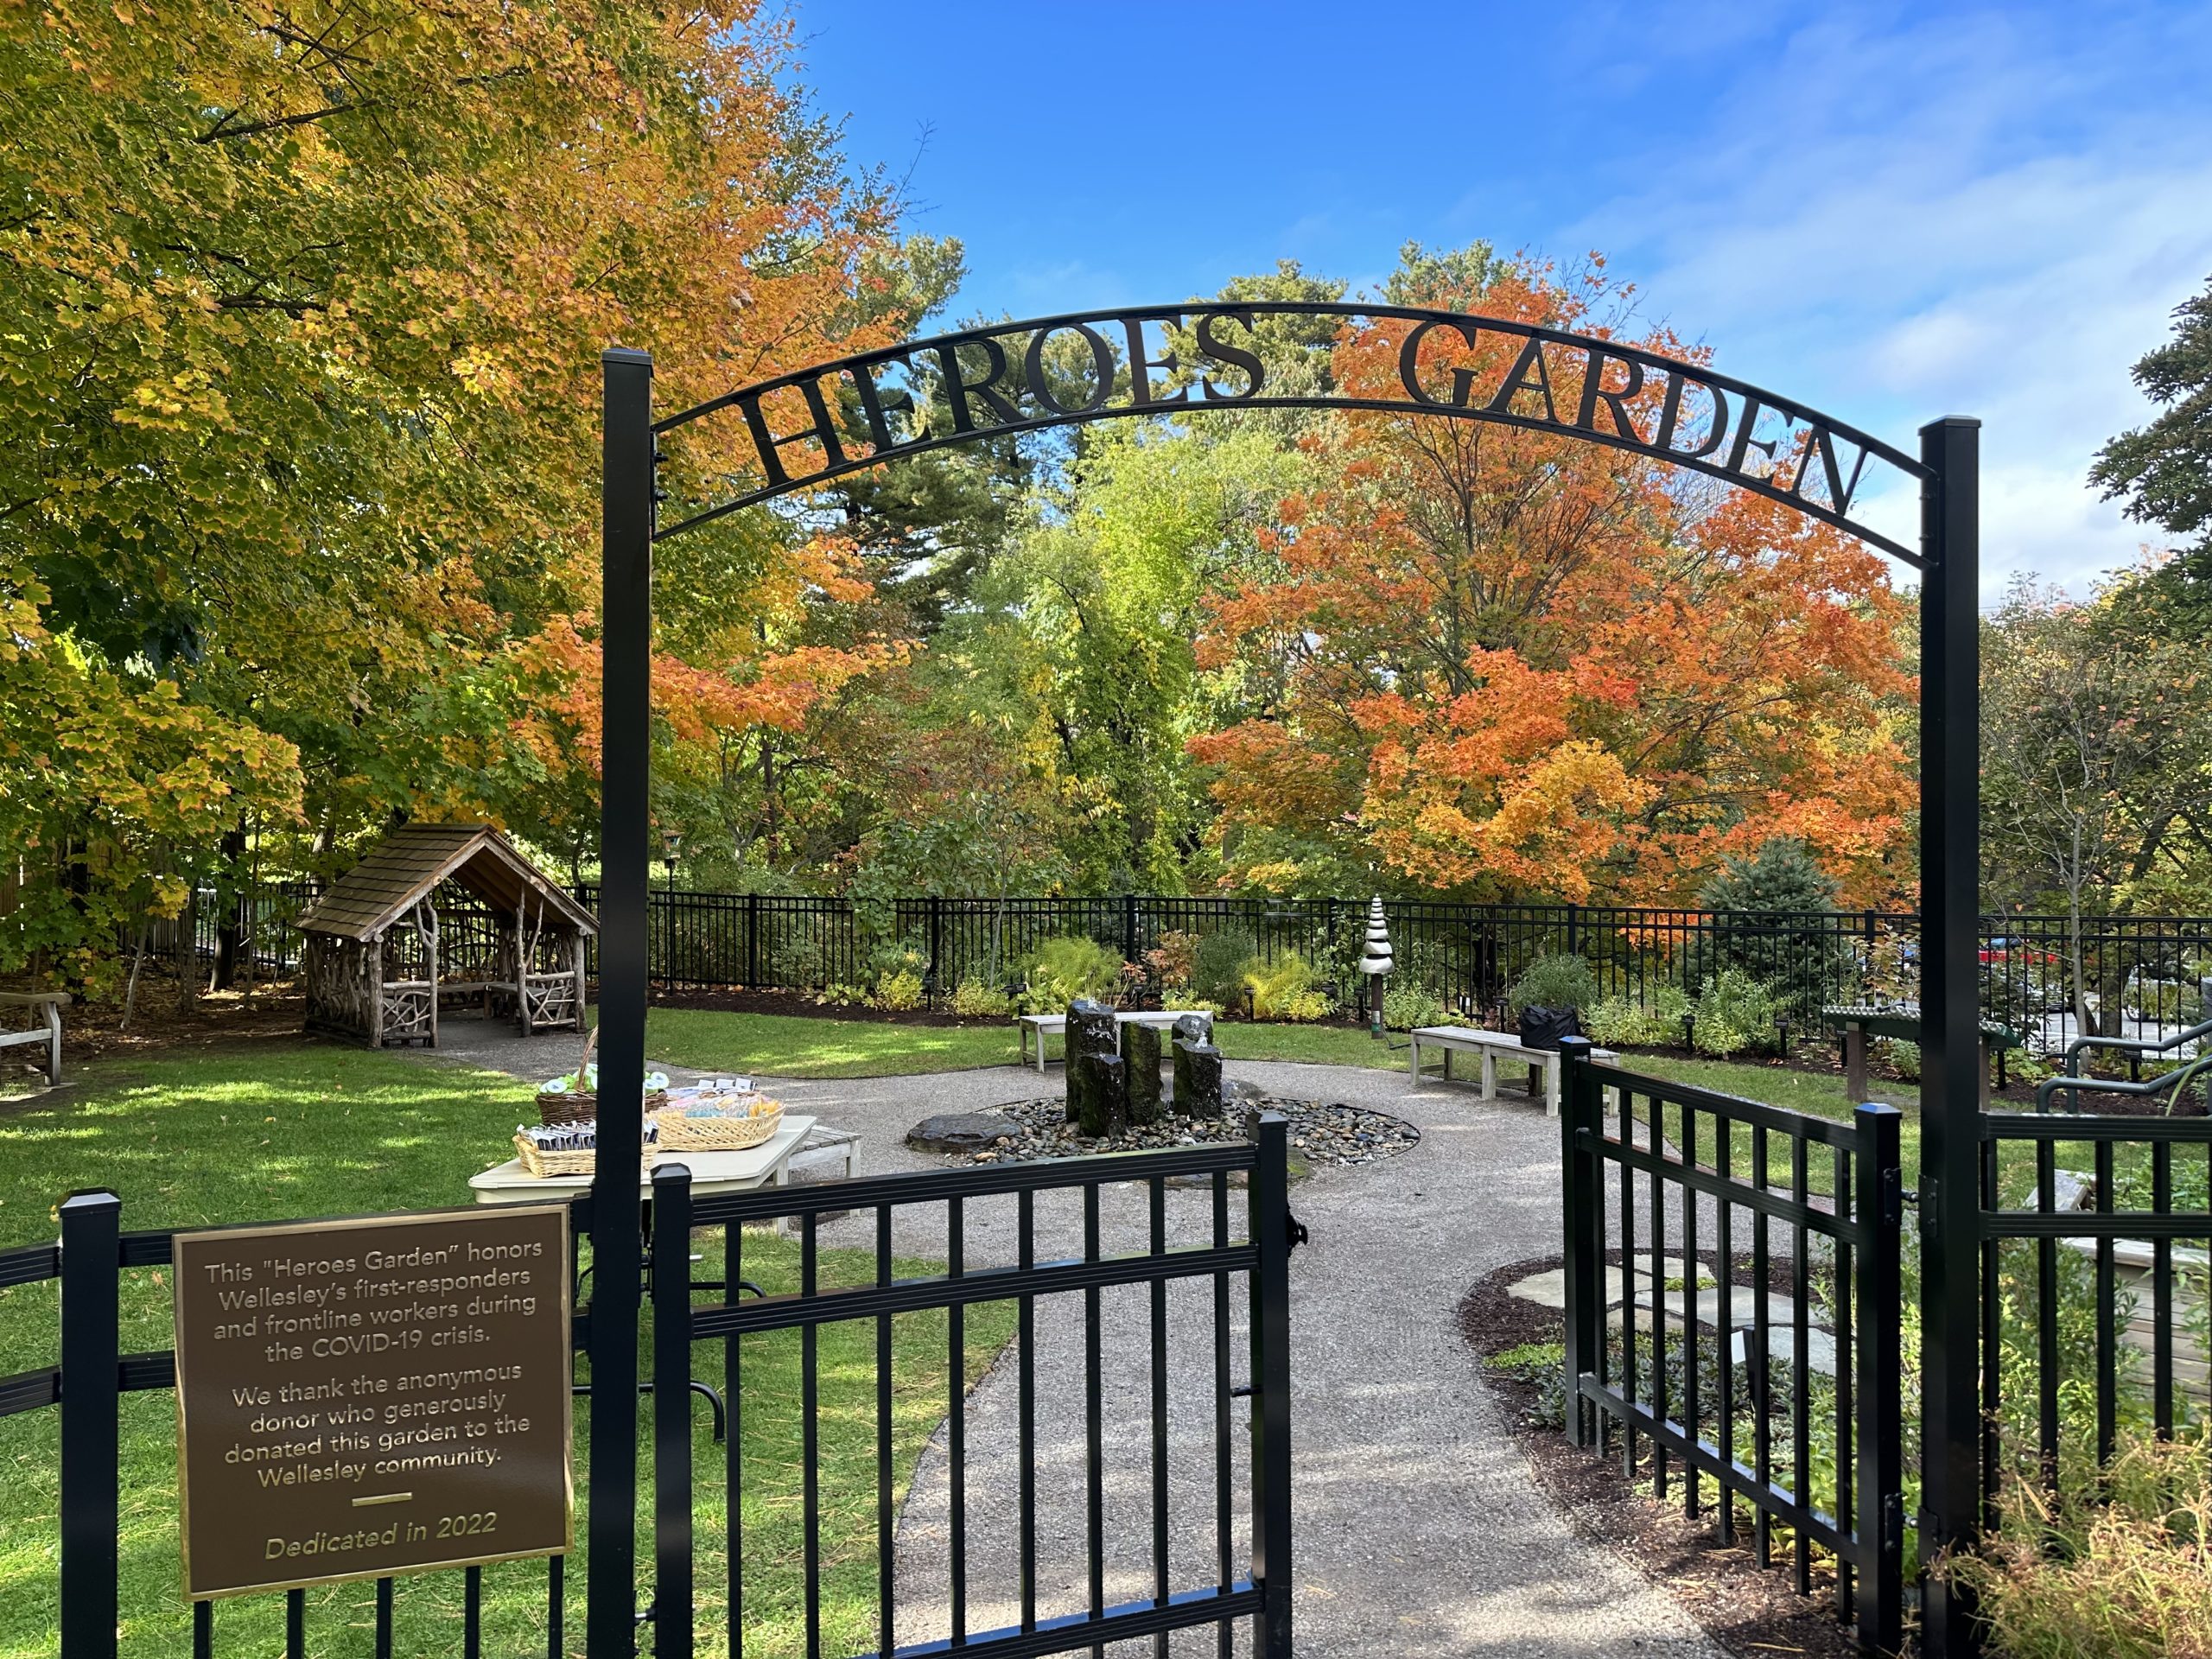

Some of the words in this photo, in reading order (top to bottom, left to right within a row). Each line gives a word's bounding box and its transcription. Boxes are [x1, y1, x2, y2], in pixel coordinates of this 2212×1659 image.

[734, 310, 1265, 488] HEROES
[1399, 321, 1873, 516] GARDEN
[205, 1263, 253, 1284] This
[467, 1240, 543, 1262] honors
[353, 1268, 531, 1300] first-responders
[213, 1317, 257, 1340] and
[264, 1309, 362, 1336] frontline
[370, 1300, 458, 1325] workers
[466, 1294, 537, 1318] during
[264, 1342, 303, 1363] the
[311, 1330, 423, 1357] COVID-19
[431, 1325, 491, 1346] crisis.
[232, 1387, 270, 1408] We
[278, 1378, 344, 1403] thank
[351, 1374, 388, 1395] the
[397, 1363, 522, 1391] anonymous
[250, 1413, 321, 1433] donor
[327, 1404, 375, 1426] who
[384, 1389, 506, 1424] generously
[224, 1435, 322, 1464] donated
[329, 1432, 371, 1452] this
[378, 1422, 457, 1452] garden
[465, 1420, 488, 1438] to
[494, 1414, 531, 1434] the
[257, 1459, 366, 1489] Wellesley
[374, 1446, 502, 1475] community.
[264, 1522, 397, 1560] Dedicated
[405, 1522, 428, 1542] in
[435, 1510, 498, 1539] 2022
